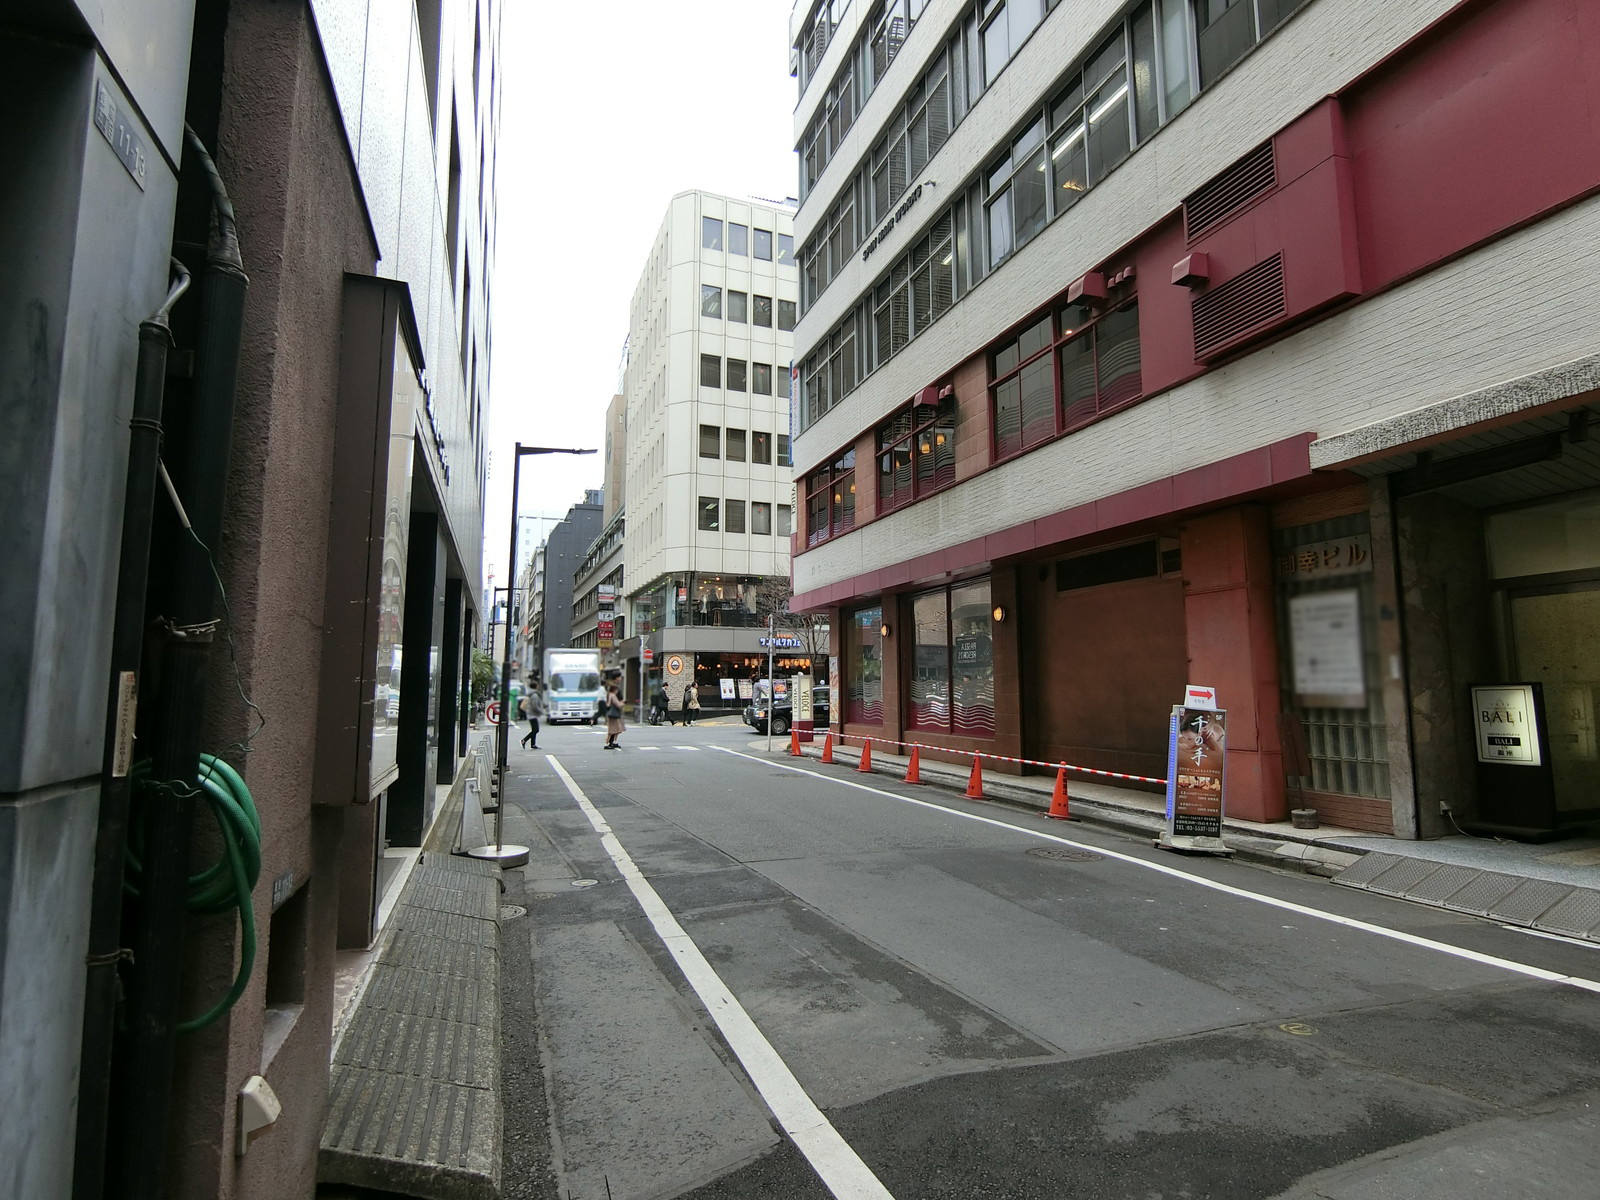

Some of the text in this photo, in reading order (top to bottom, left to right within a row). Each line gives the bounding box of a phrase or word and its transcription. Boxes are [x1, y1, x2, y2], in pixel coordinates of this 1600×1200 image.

[119, 125, 145, 177] 11-13
[877, 217, 895, 244] HAIR
[1278, 543, 1367, 576] 御幸ビル
[1481, 711, 1523, 723] BALI
[1190, 715, 1209, 767] 千の手
